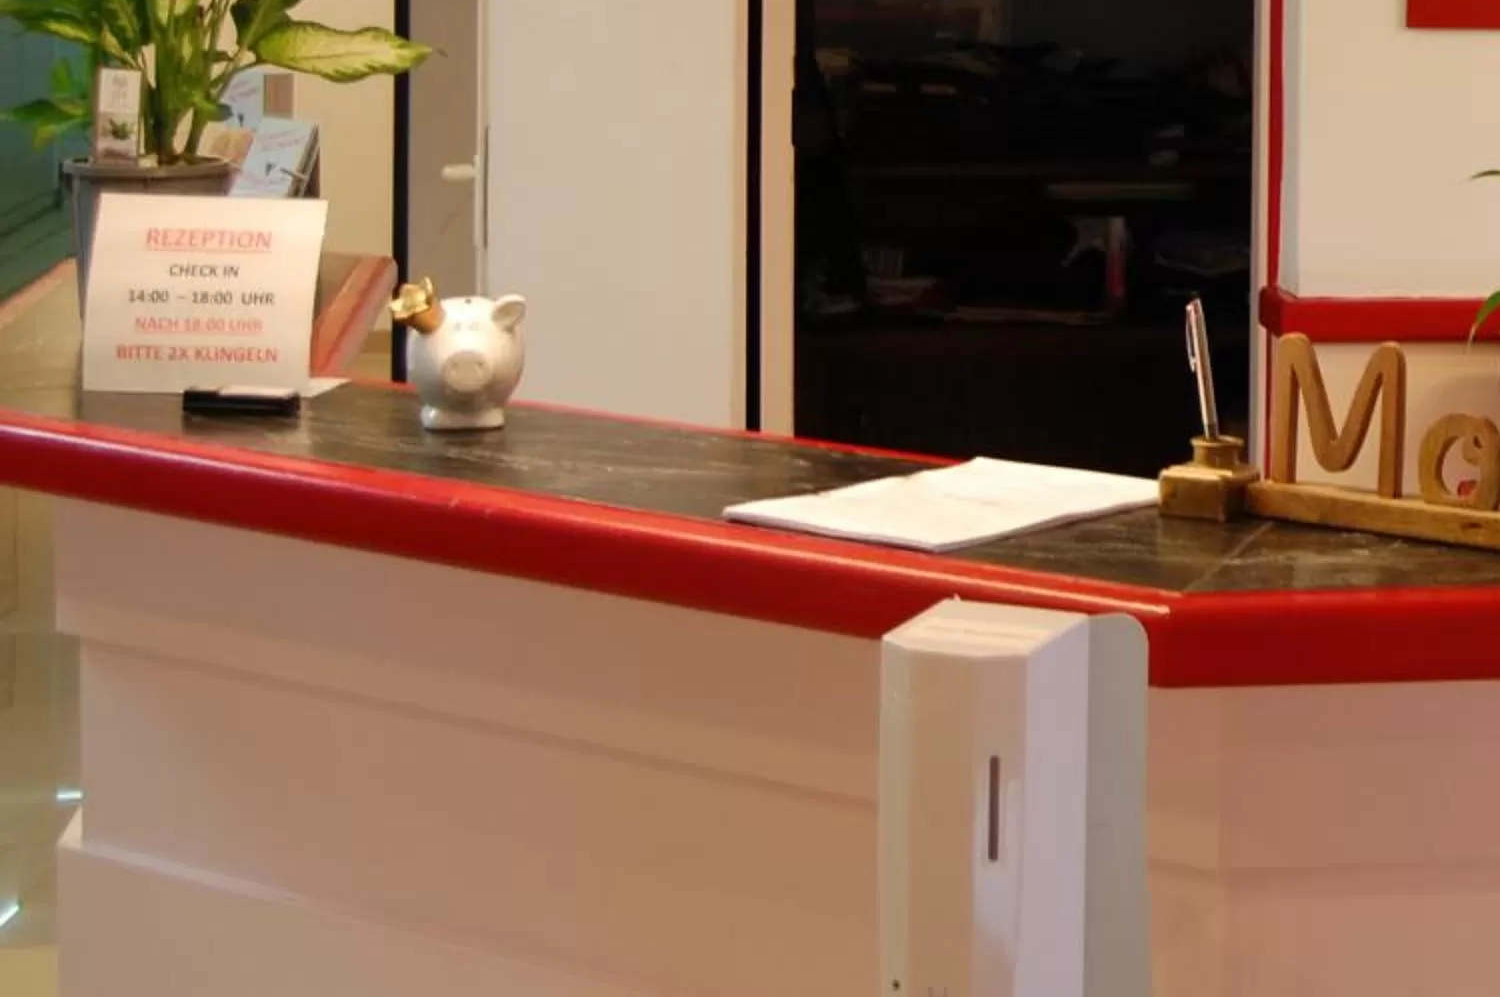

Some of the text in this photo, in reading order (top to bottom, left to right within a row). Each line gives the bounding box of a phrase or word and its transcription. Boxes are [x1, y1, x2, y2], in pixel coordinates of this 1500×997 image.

[145, 227, 273, 251] REZEPTION
[169, 263, 240, 278] CHECK IN
[127, 289, 170, 303] 14:00
[190, 290, 233, 305] 18:00
[241, 292, 276, 306] UHR
[134, 317, 179, 332] NACH
[228, 318, 263, 333] UHR
[115, 344, 163, 361] BITTE
[194, 345, 279, 364] KLINGELN
